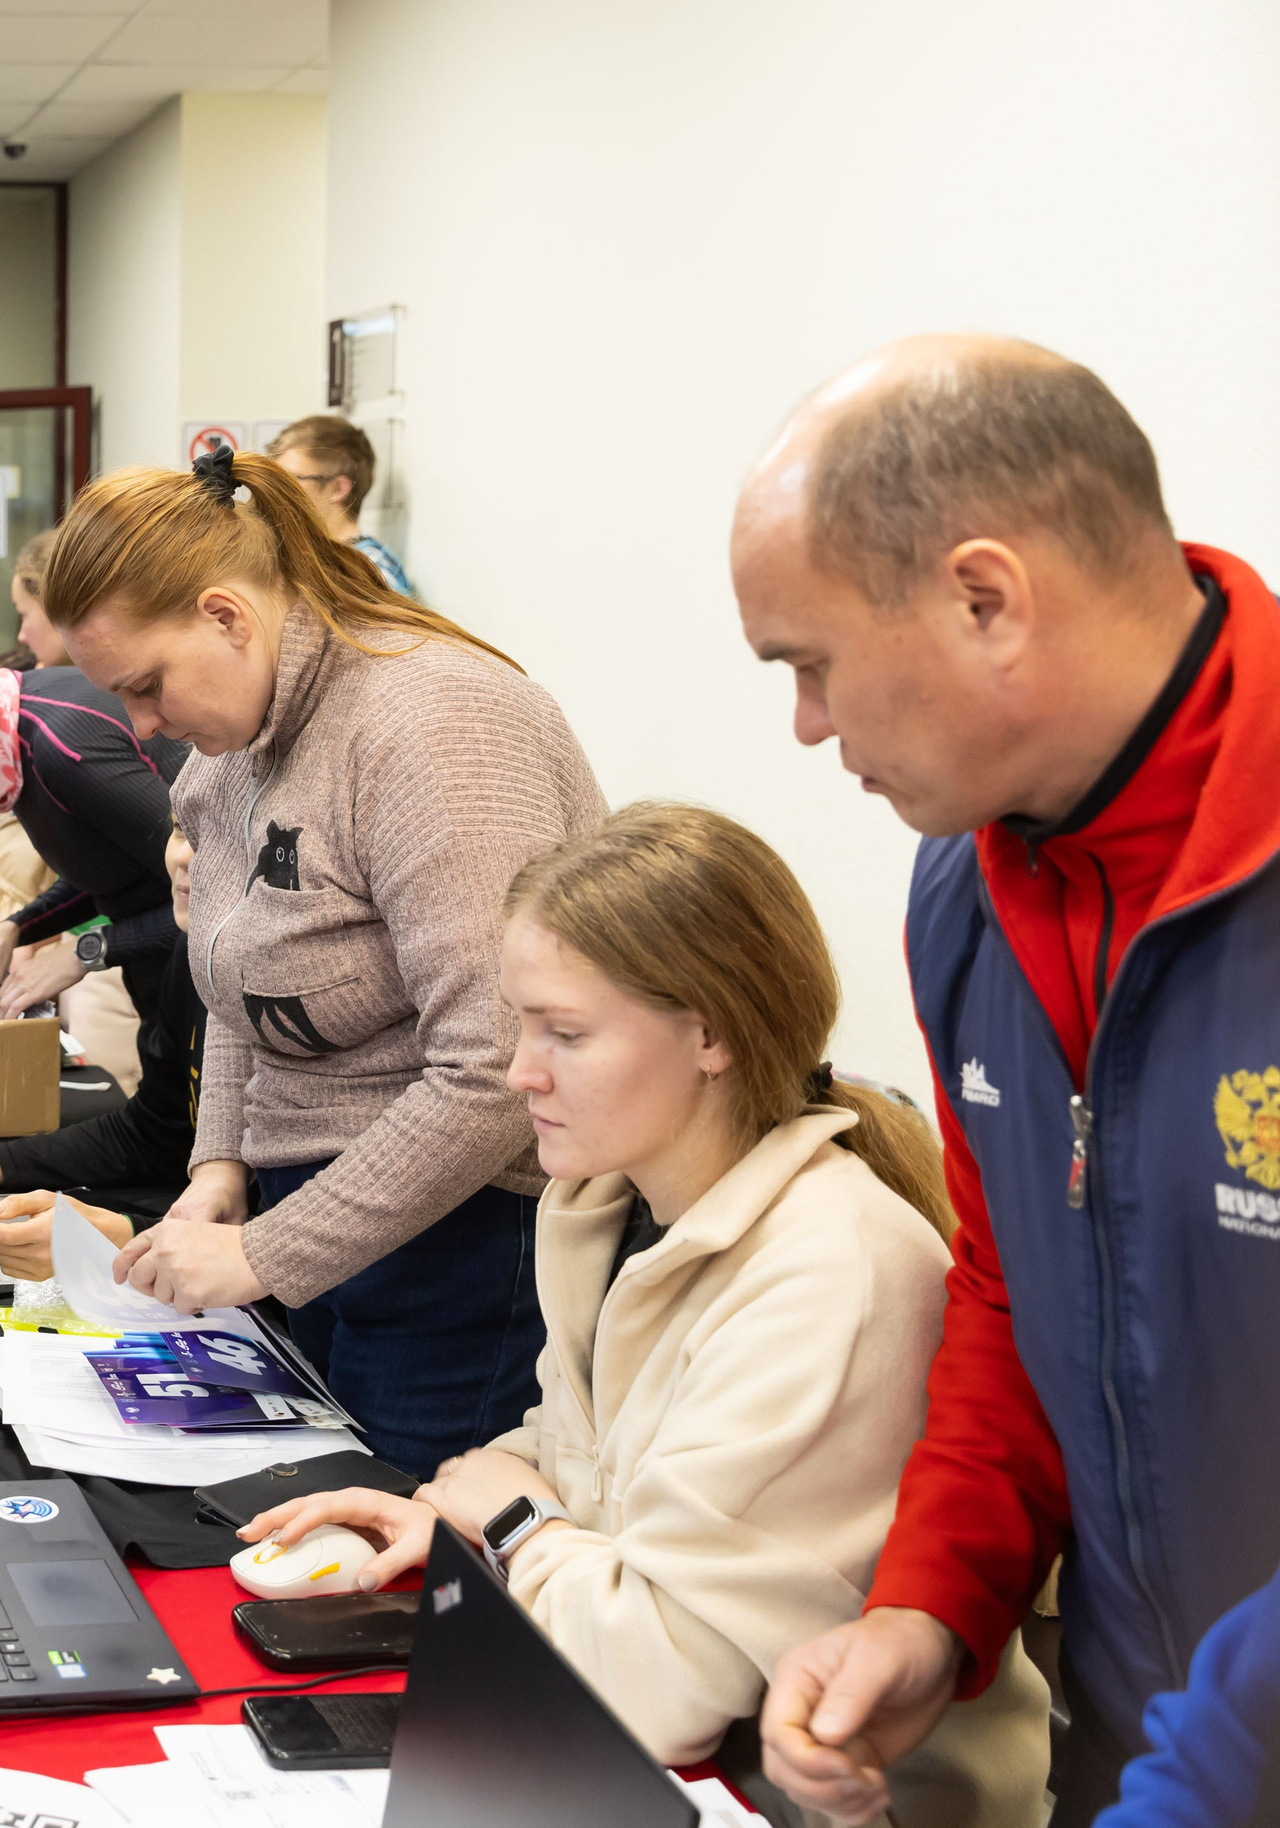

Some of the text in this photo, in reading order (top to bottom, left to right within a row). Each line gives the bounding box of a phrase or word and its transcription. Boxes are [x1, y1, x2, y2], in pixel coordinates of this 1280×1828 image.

[1214, 1182, 1280, 1223] RUS
[198, 1334, 267, 1376] 46
[136, 1373, 210, 1398] 51
